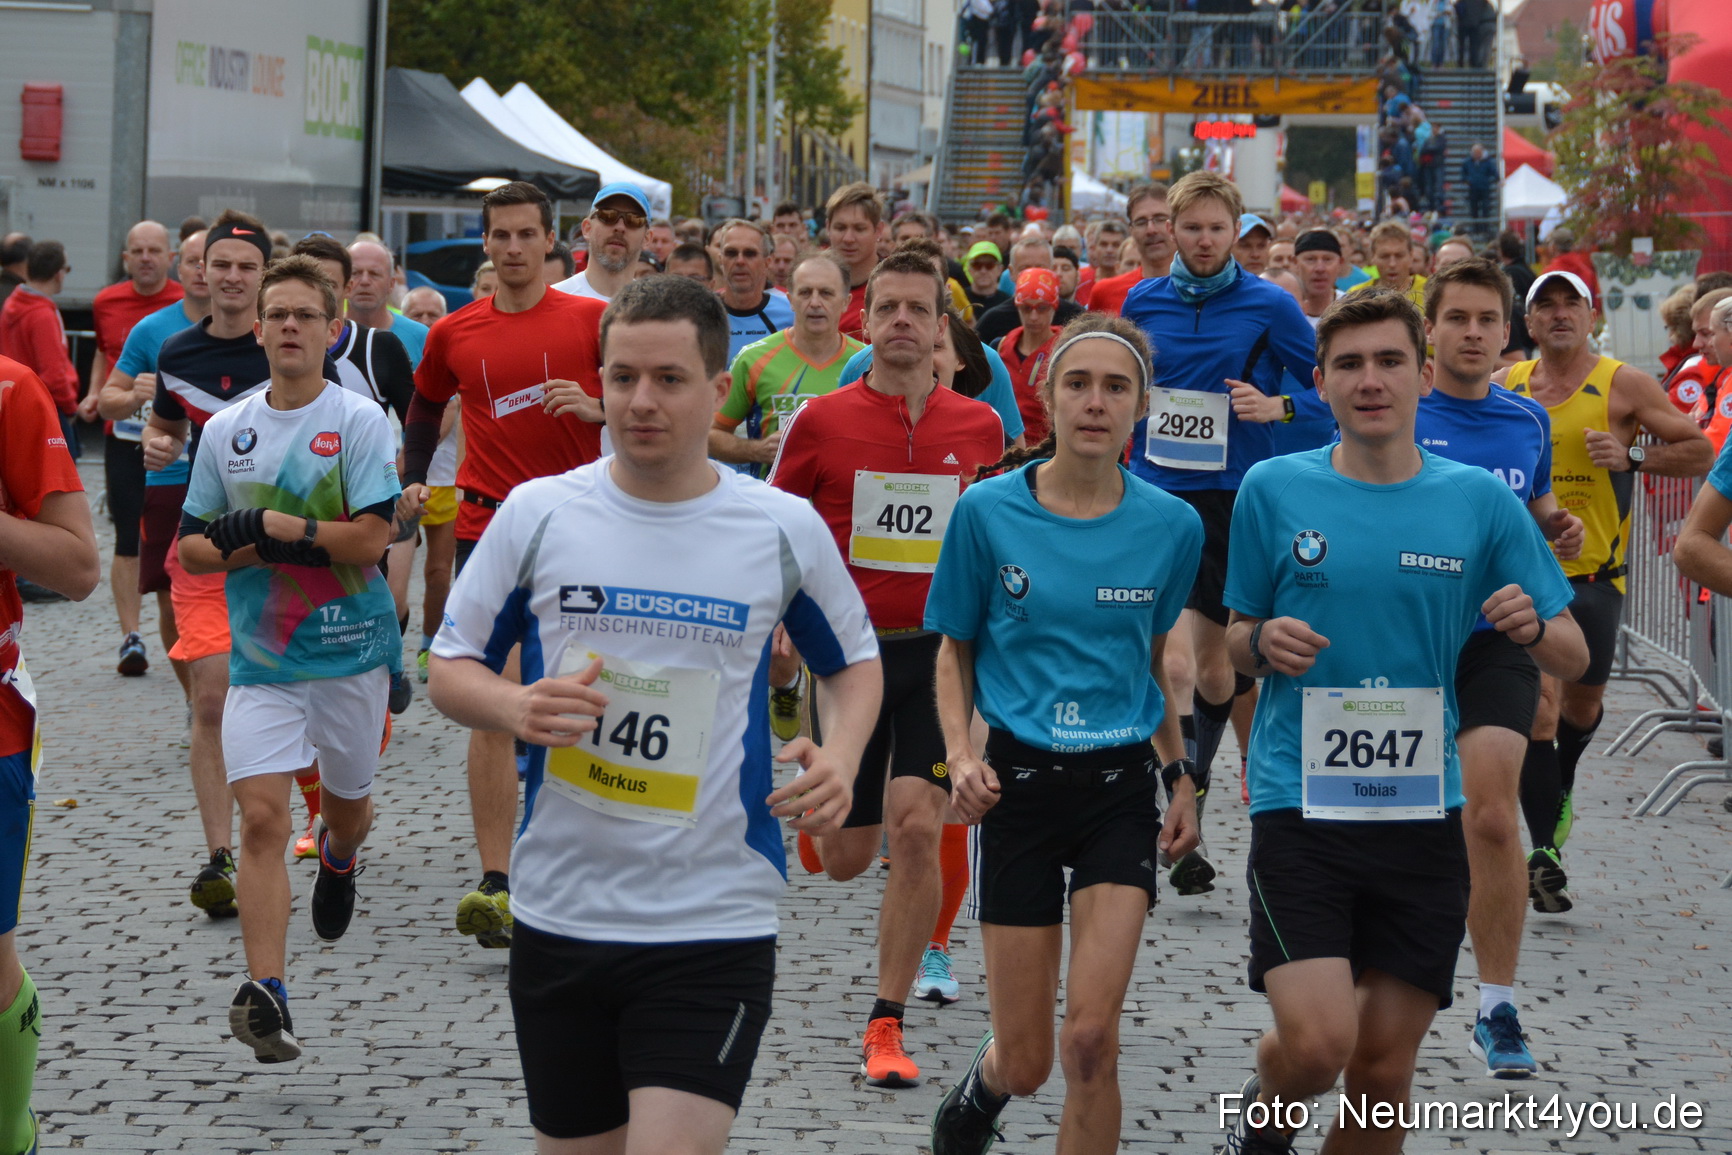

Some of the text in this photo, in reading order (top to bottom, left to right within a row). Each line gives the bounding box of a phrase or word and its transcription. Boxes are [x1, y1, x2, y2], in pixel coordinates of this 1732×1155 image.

[304, 46, 364, 130] BOCK
[1192, 84, 1259, 108] ZIEL
[508, 393, 531, 408] DEHN
[1158, 412, 1214, 439] 2928
[228, 459, 255, 468] PARTL
[894, 483, 930, 492] BOCK
[877, 504, 933, 534] 402
[1400, 552, 1464, 573] BOCK
[1294, 572, 1329, 581] PARTL
[1096, 587, 1156, 602] BOCK
[320, 605, 347, 623] 17.
[615, 592, 742, 626] BÜSCHEL
[321, 618, 376, 634] Neumarkter
[560, 615, 744, 649] FEINSCHNEIDTEAM
[321, 630, 367, 645] Stadtlauf
[614, 672, 670, 693] BOCK
[1053, 702, 1086, 726] 18.
[1357, 701, 1406, 712] BOCK
[592, 703, 670, 761] 146
[1051, 726, 1133, 740] Neumarkter
[1324, 729, 1423, 768] 2647
[1310, 762, 1316, 770] B
[588, 763, 648, 793] Markus
[1352, 783, 1397, 797] Tobias
